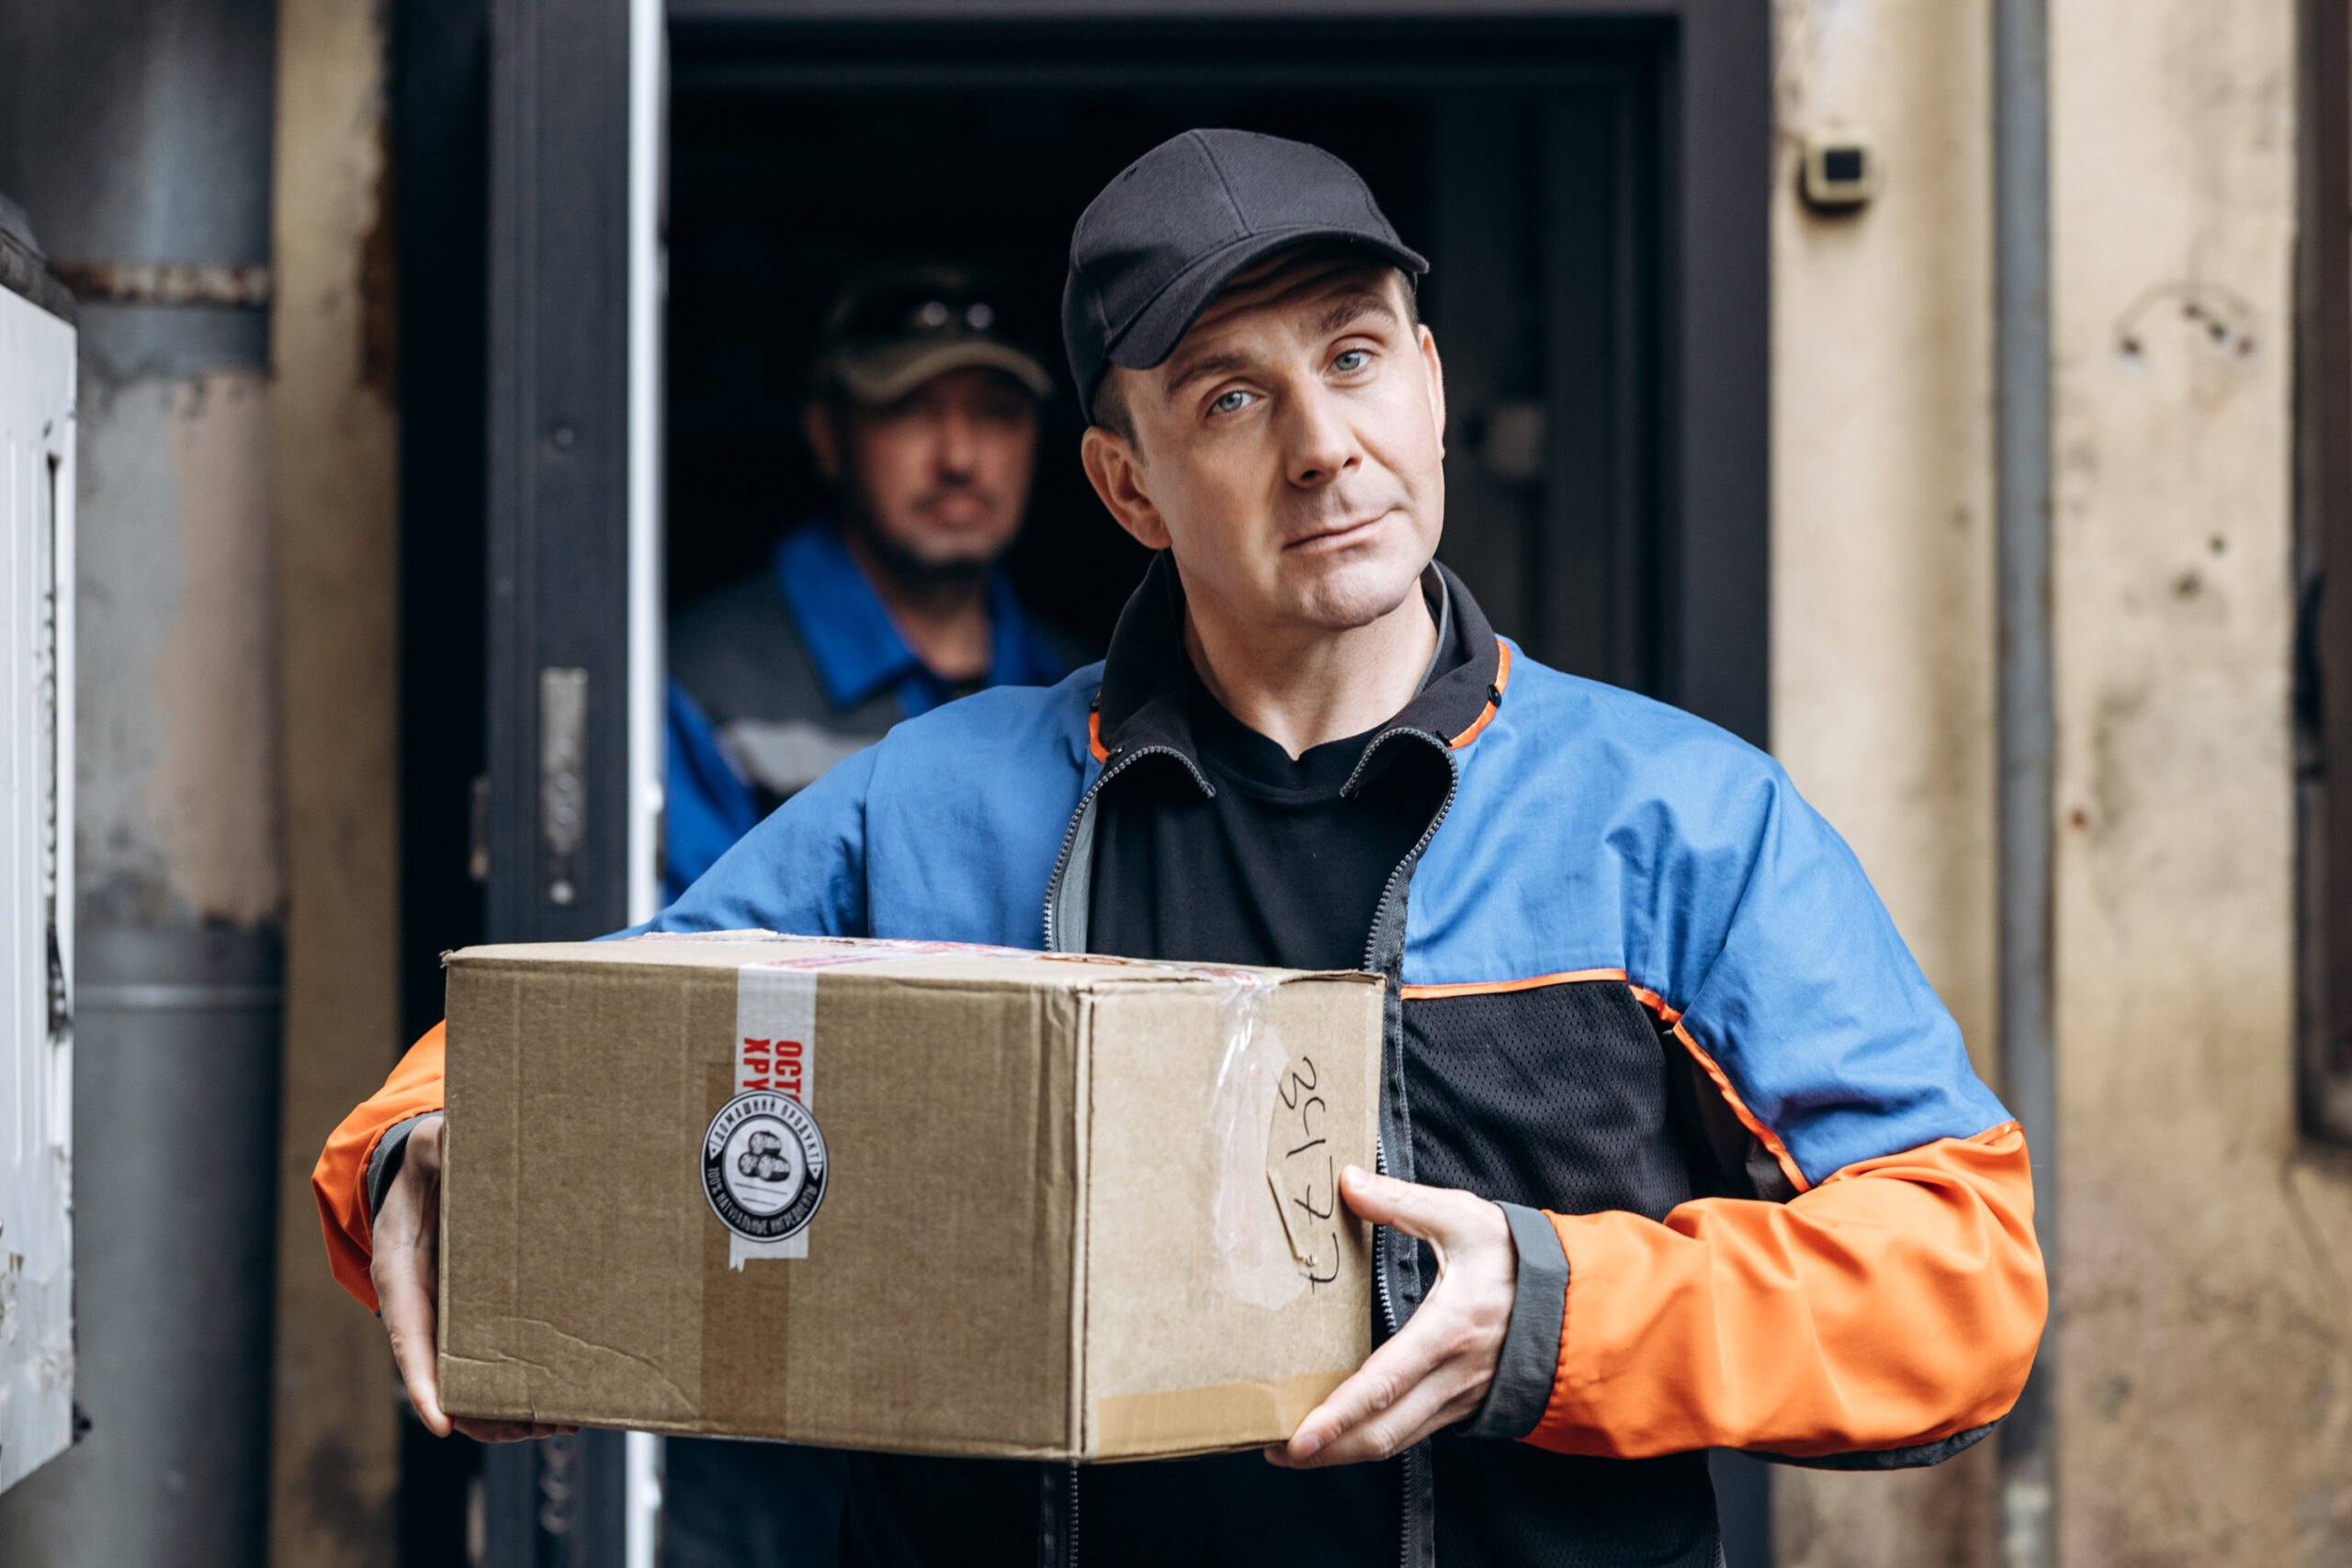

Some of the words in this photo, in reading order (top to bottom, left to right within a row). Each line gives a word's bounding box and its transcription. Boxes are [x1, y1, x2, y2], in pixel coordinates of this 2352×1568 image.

[775, 1040, 802, 1103] ОСТ
[715, 1098, 775, 1141] ДОМАШНИЙ
[780, 1104, 820, 1157] ПРОДУКТ
[707, 1167, 723, 1194] 100%
